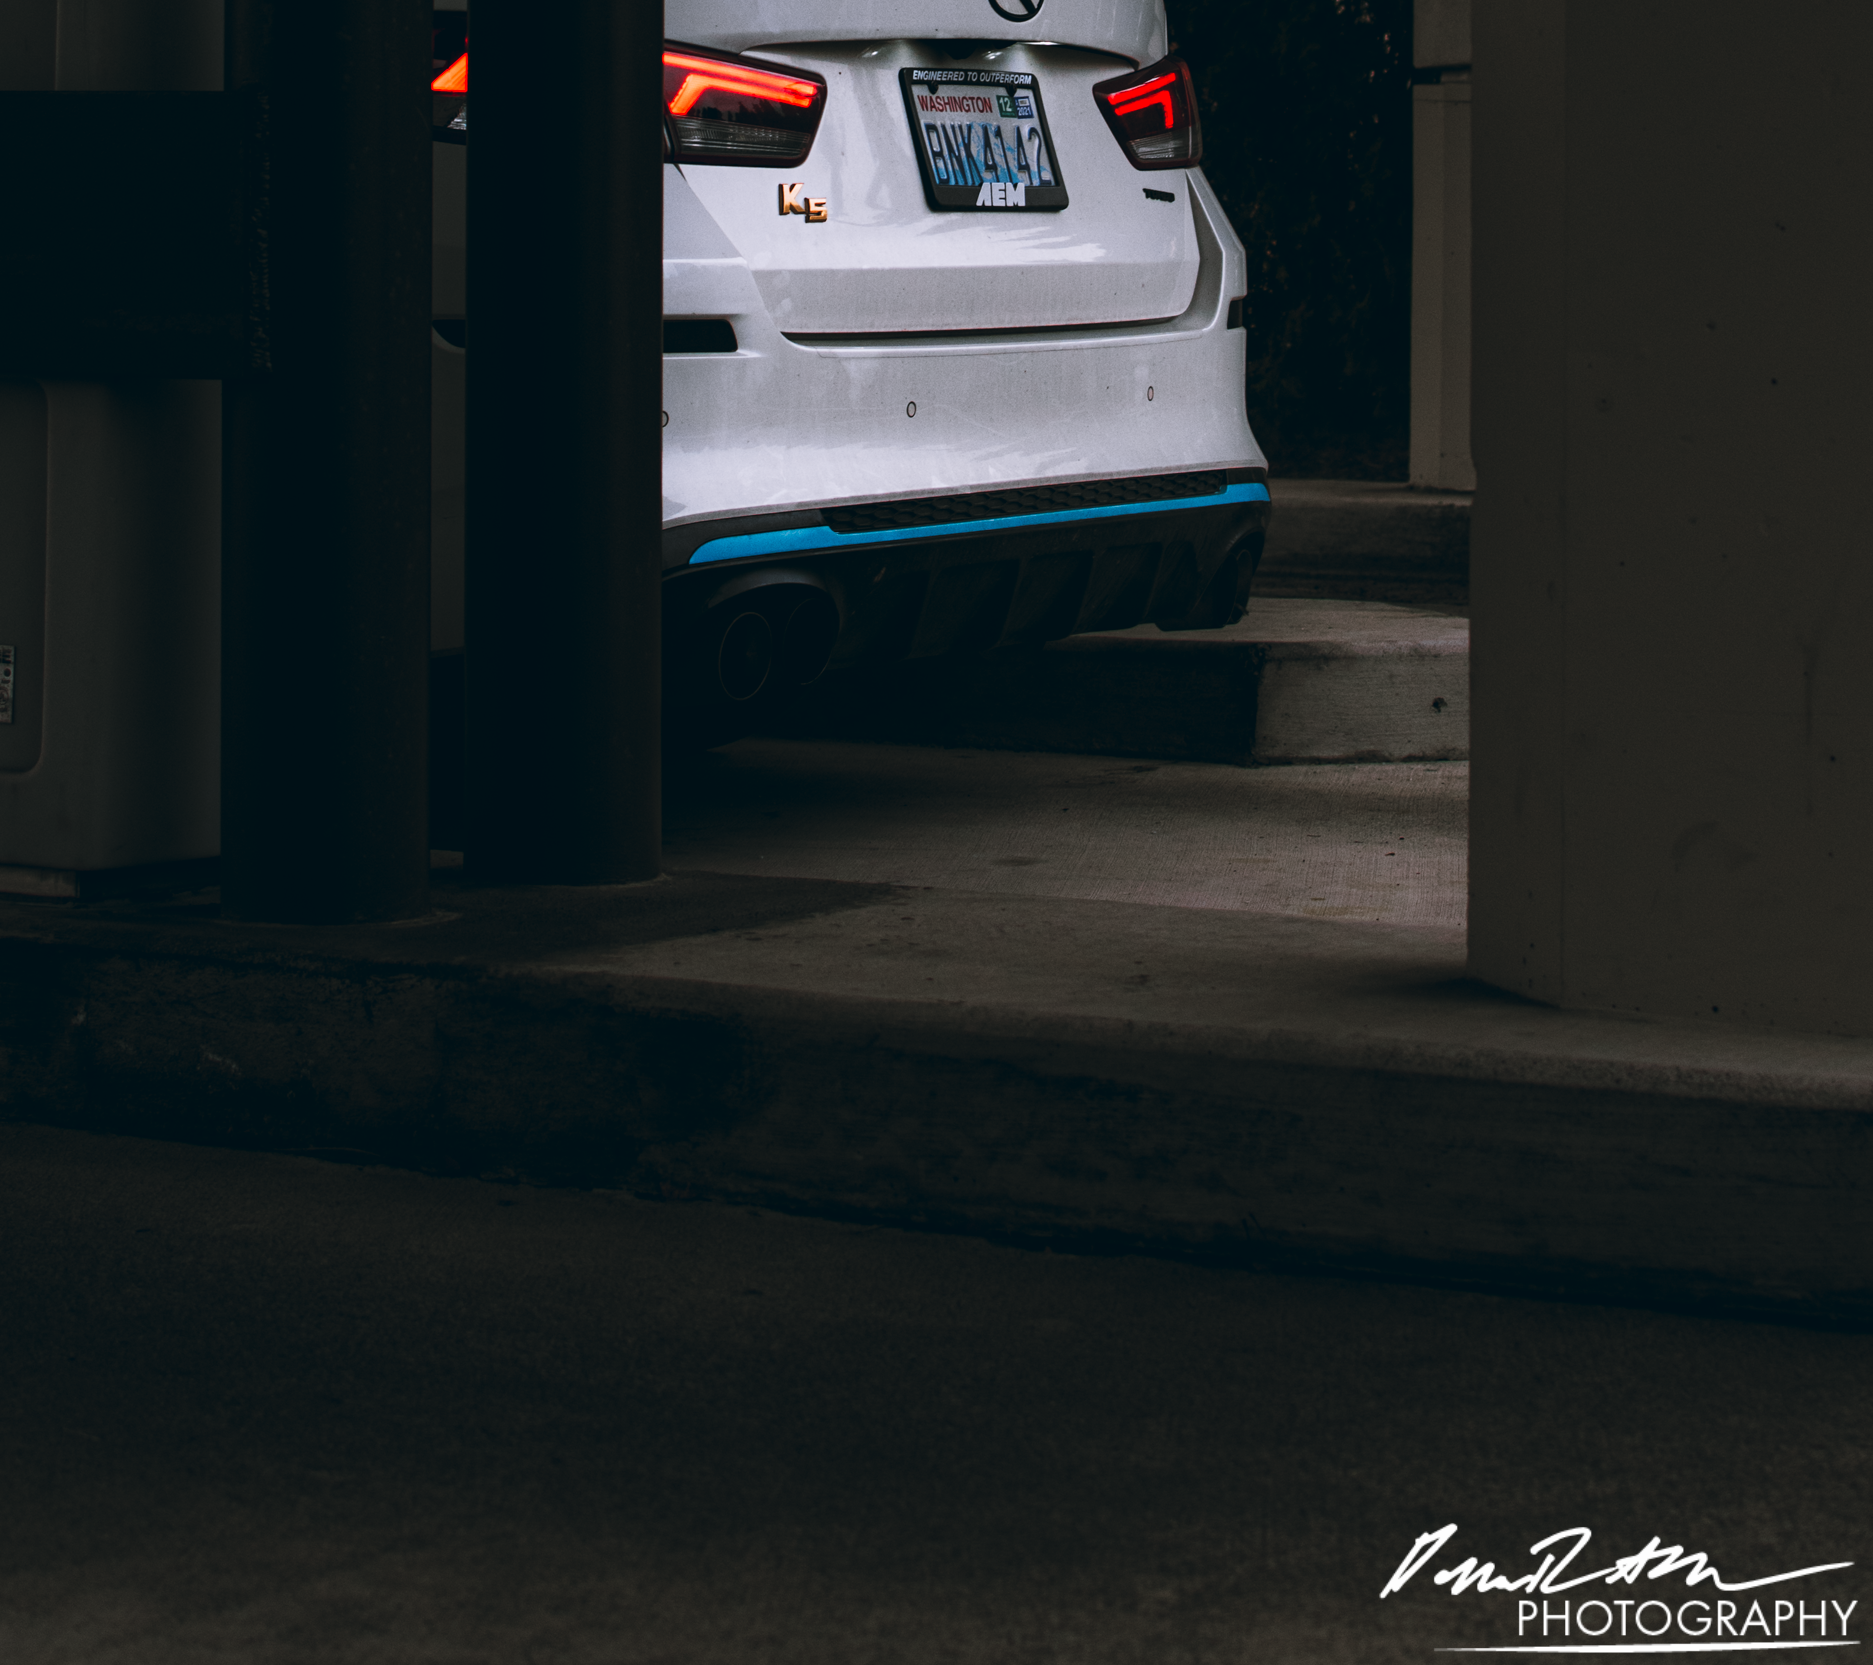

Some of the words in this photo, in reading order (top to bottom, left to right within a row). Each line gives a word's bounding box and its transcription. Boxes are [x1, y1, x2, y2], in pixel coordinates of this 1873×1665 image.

[912, 70, 964, 82] ENGINEERED
[967, 71, 978, 82] TO
[980, 72, 1032, 85] OUTPERFORM
[917, 95, 993, 113] WASHINGTON
[999, 96, 1013, 112] 12
[1016, 106, 1032, 116] 2021
[923, 122, 1052, 185] BNK4142
[778, 182, 828, 223] K5
[976, 182, 1026, 207] AEM
